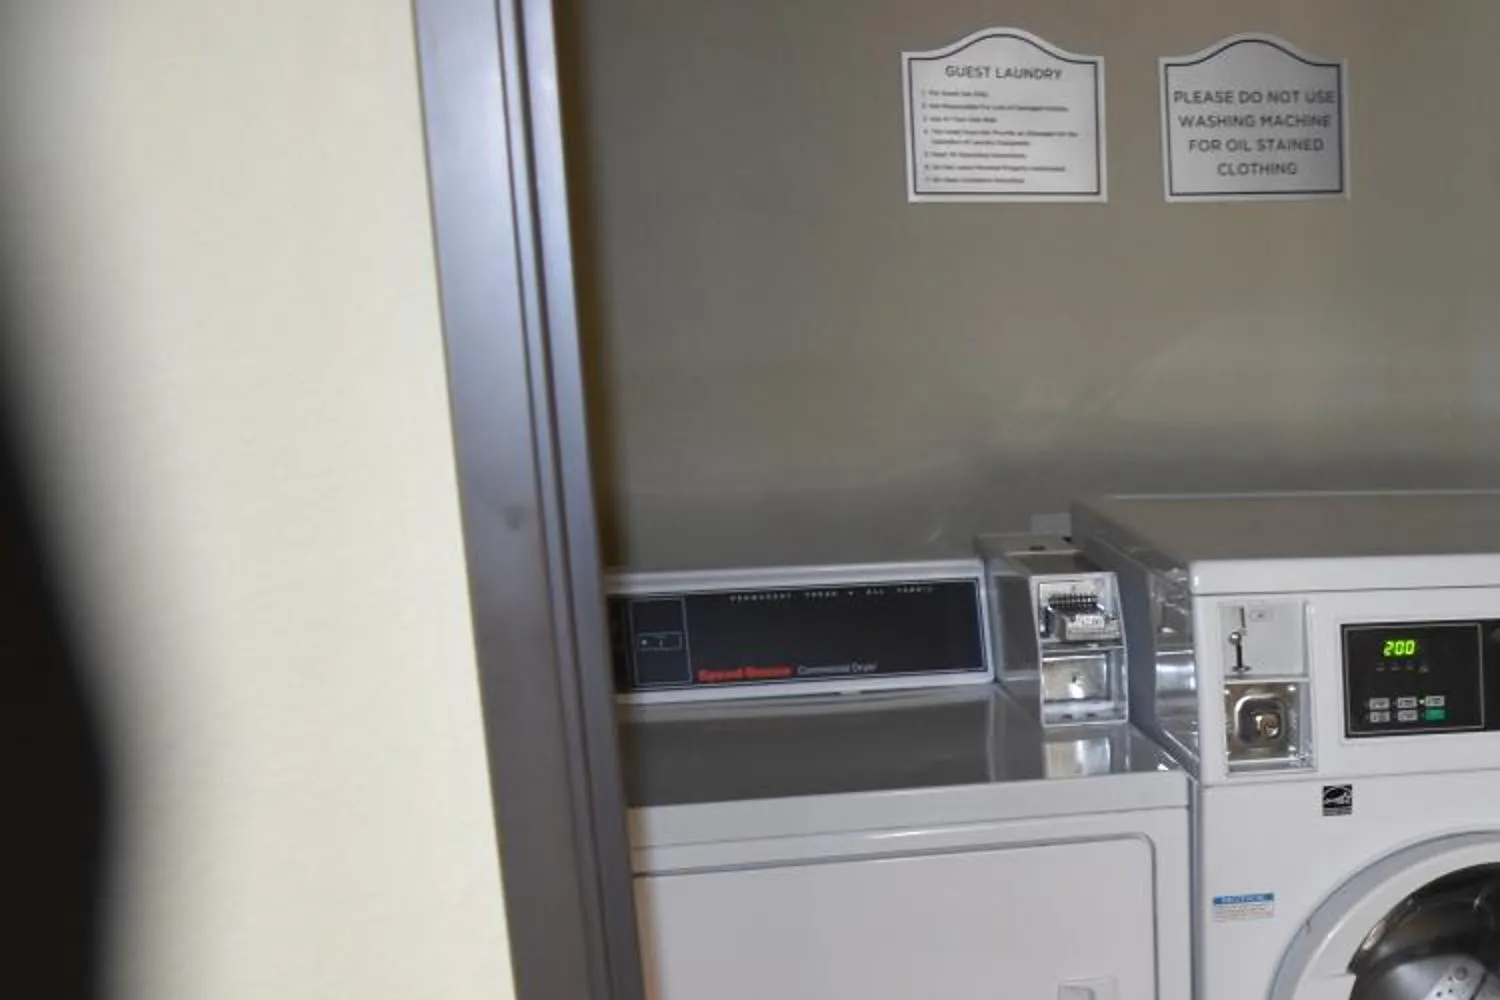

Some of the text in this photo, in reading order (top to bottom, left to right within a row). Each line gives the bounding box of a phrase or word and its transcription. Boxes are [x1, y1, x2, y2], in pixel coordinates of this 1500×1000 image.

[945, 65, 1063, 81] GUEST LAUNDRY
[1173, 90, 1336, 104] PLEASE DO NOT USE
[1178, 114, 1332, 128] WASHING MACHINE
[1188, 138, 1325, 152] FOR OIL STAINED
[1216, 161, 1298, 176] CLOTHING
[1383, 640, 1416, 656] 200
